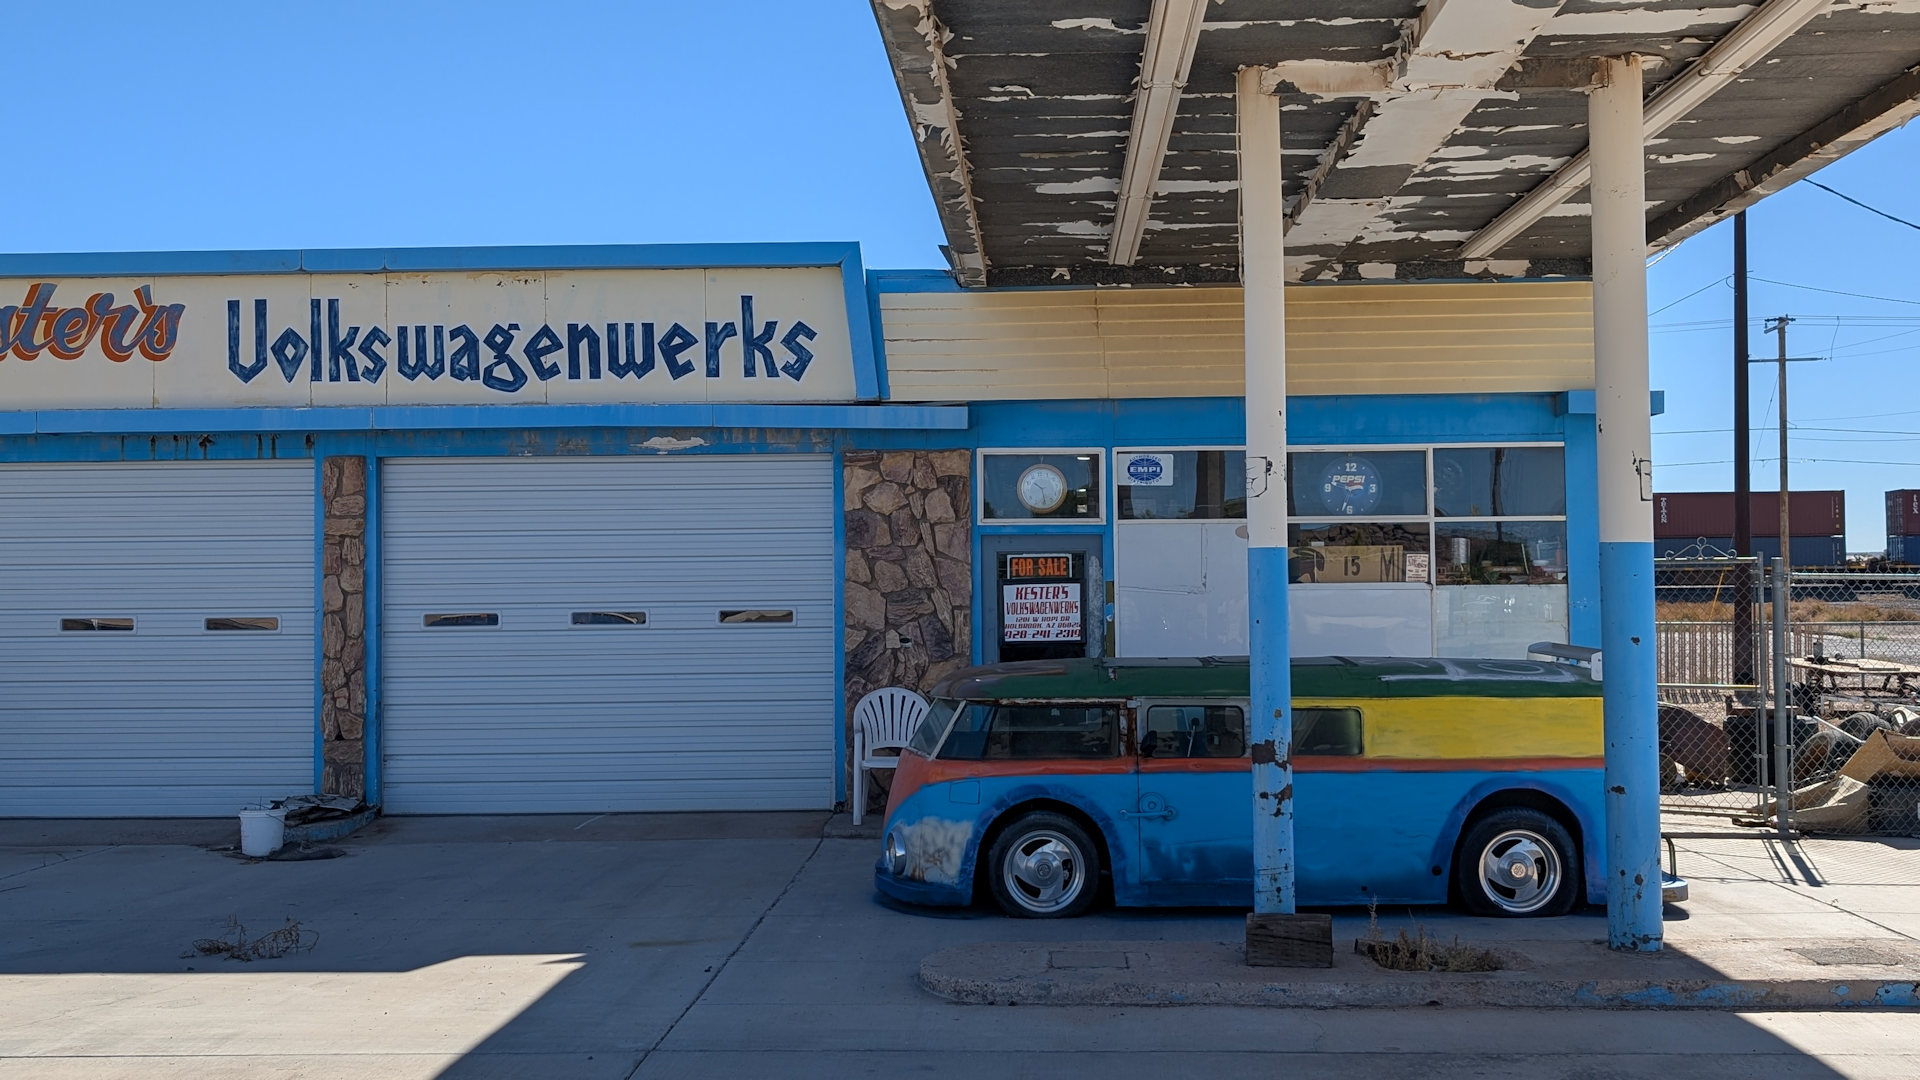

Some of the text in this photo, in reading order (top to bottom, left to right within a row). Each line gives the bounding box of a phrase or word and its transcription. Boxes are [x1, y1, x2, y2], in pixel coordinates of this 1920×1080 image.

[227, 294, 818, 392] Volkswagenwerks
[1345, 463, 1357, 472] 12
[1332, 475, 1366, 483] PEPSI
[1324, 483, 1331, 492] 9
[1369, 484, 1376, 493] 3
[1346, 505, 1353, 514] 6
[1011, 557, 1067, 576] FOR SALE
[1343, 555, 1360, 576] 15
[1015, 585, 1069, 600] KESTER'S
[1006, 601, 1079, 615] VOLKSWAGENWERKS
[1004, 629, 1082, 639] 928-241-2319
